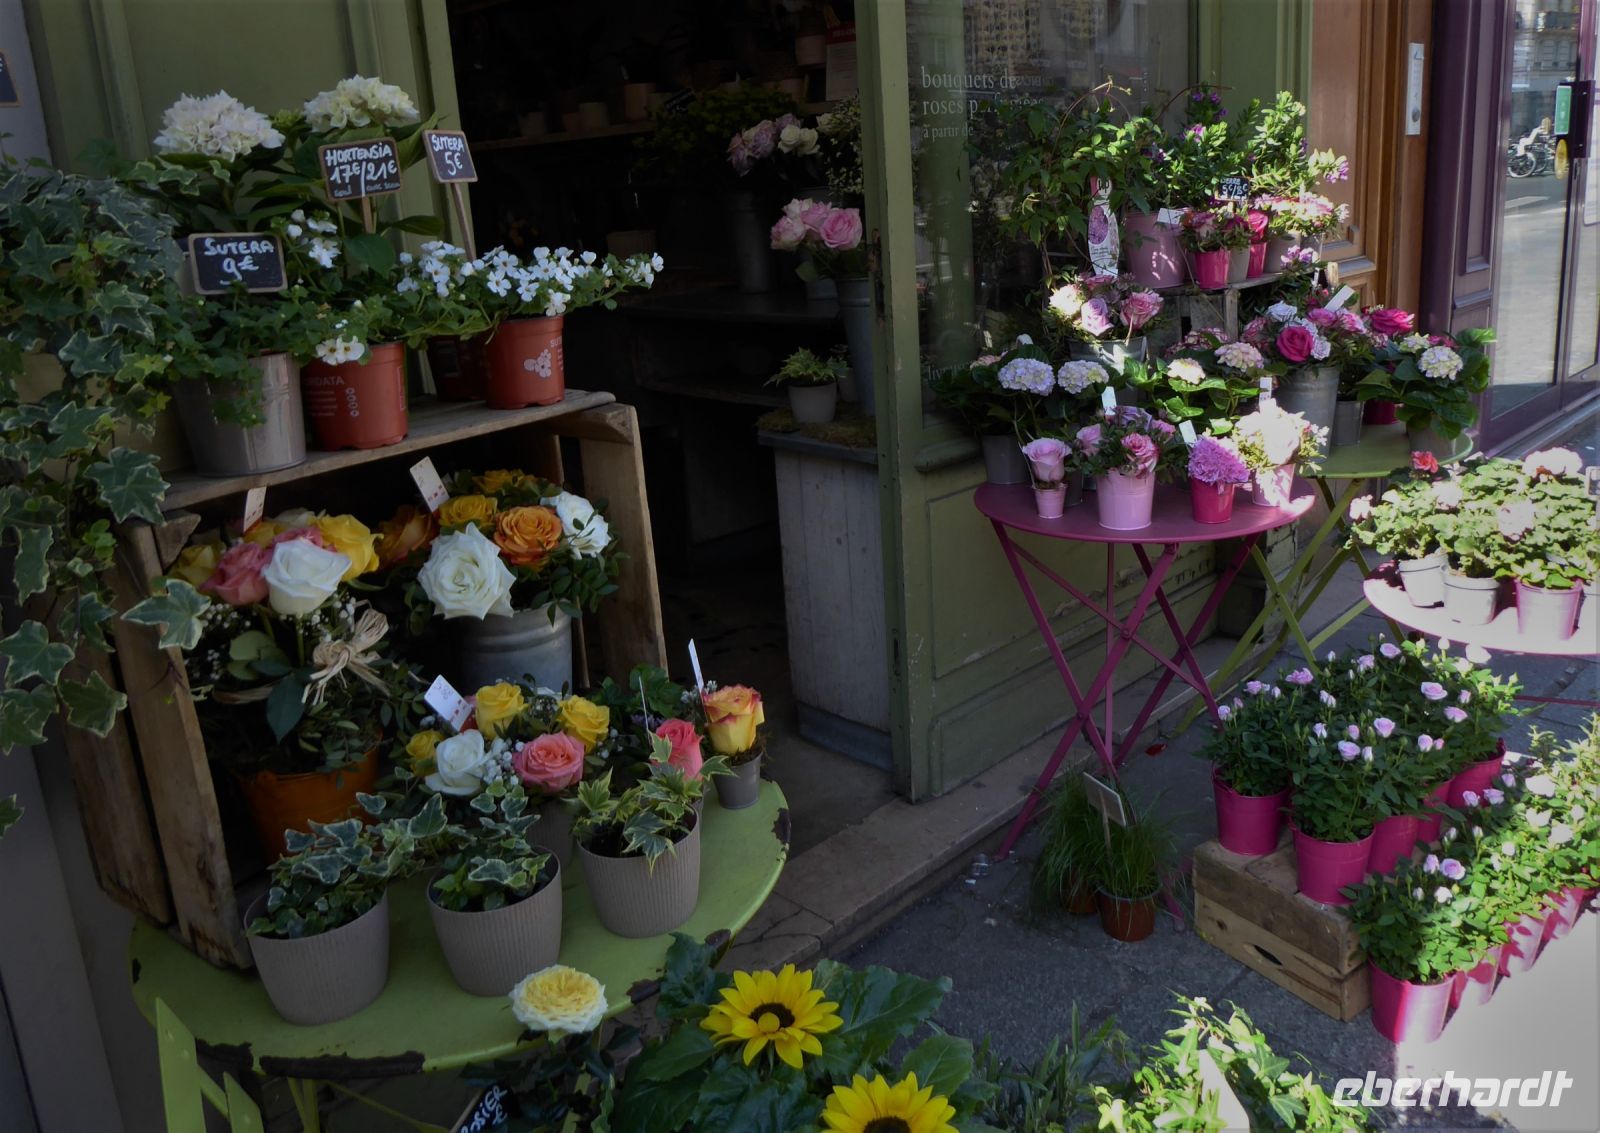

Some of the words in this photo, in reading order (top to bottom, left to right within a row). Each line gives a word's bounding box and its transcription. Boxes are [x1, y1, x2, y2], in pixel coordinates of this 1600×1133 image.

[921, 65, 995, 96] bouquets
[999, 67, 1016, 89] de
[922, 100, 963, 115] roses
[932, 125, 960, 142] partir
[961, 121, 974, 136] de
[431, 134, 464, 151] SUTERA
[444, 151, 463, 175] 5€
[204, 237, 274, 256] SUTERA
[223, 255, 259, 281] 9€
